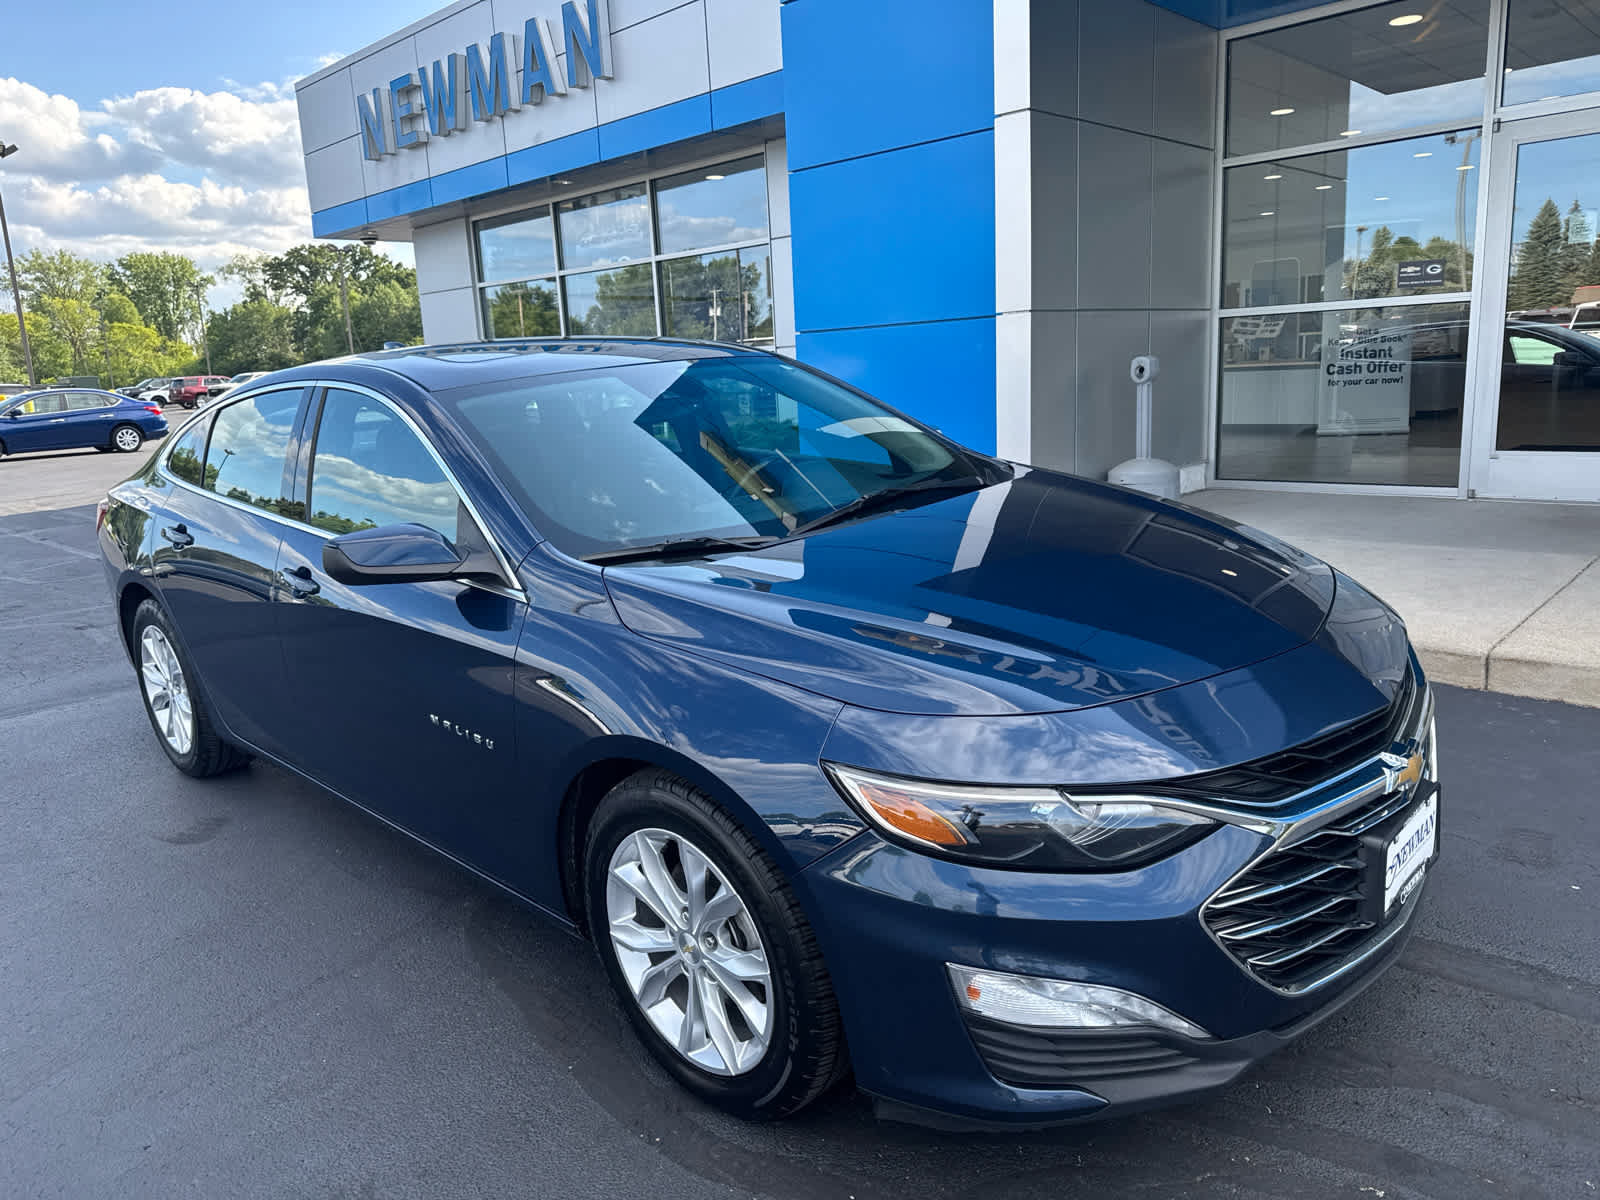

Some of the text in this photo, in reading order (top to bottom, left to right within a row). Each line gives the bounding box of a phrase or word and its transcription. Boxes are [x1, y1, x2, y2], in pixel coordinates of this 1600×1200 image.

[357, 0, 611, 161] NEWMAN
[1340, 346, 1393, 360] Instant
[1326, 361, 1406, 375] Cash Offer
[1328, 379, 1339, 387] for
[1342, 379, 1363, 388] your
[1381, 376, 1403, 385] now!
[429, 713, 495, 750] MALIBU
[1394, 811, 1436, 869] NEWMAN
